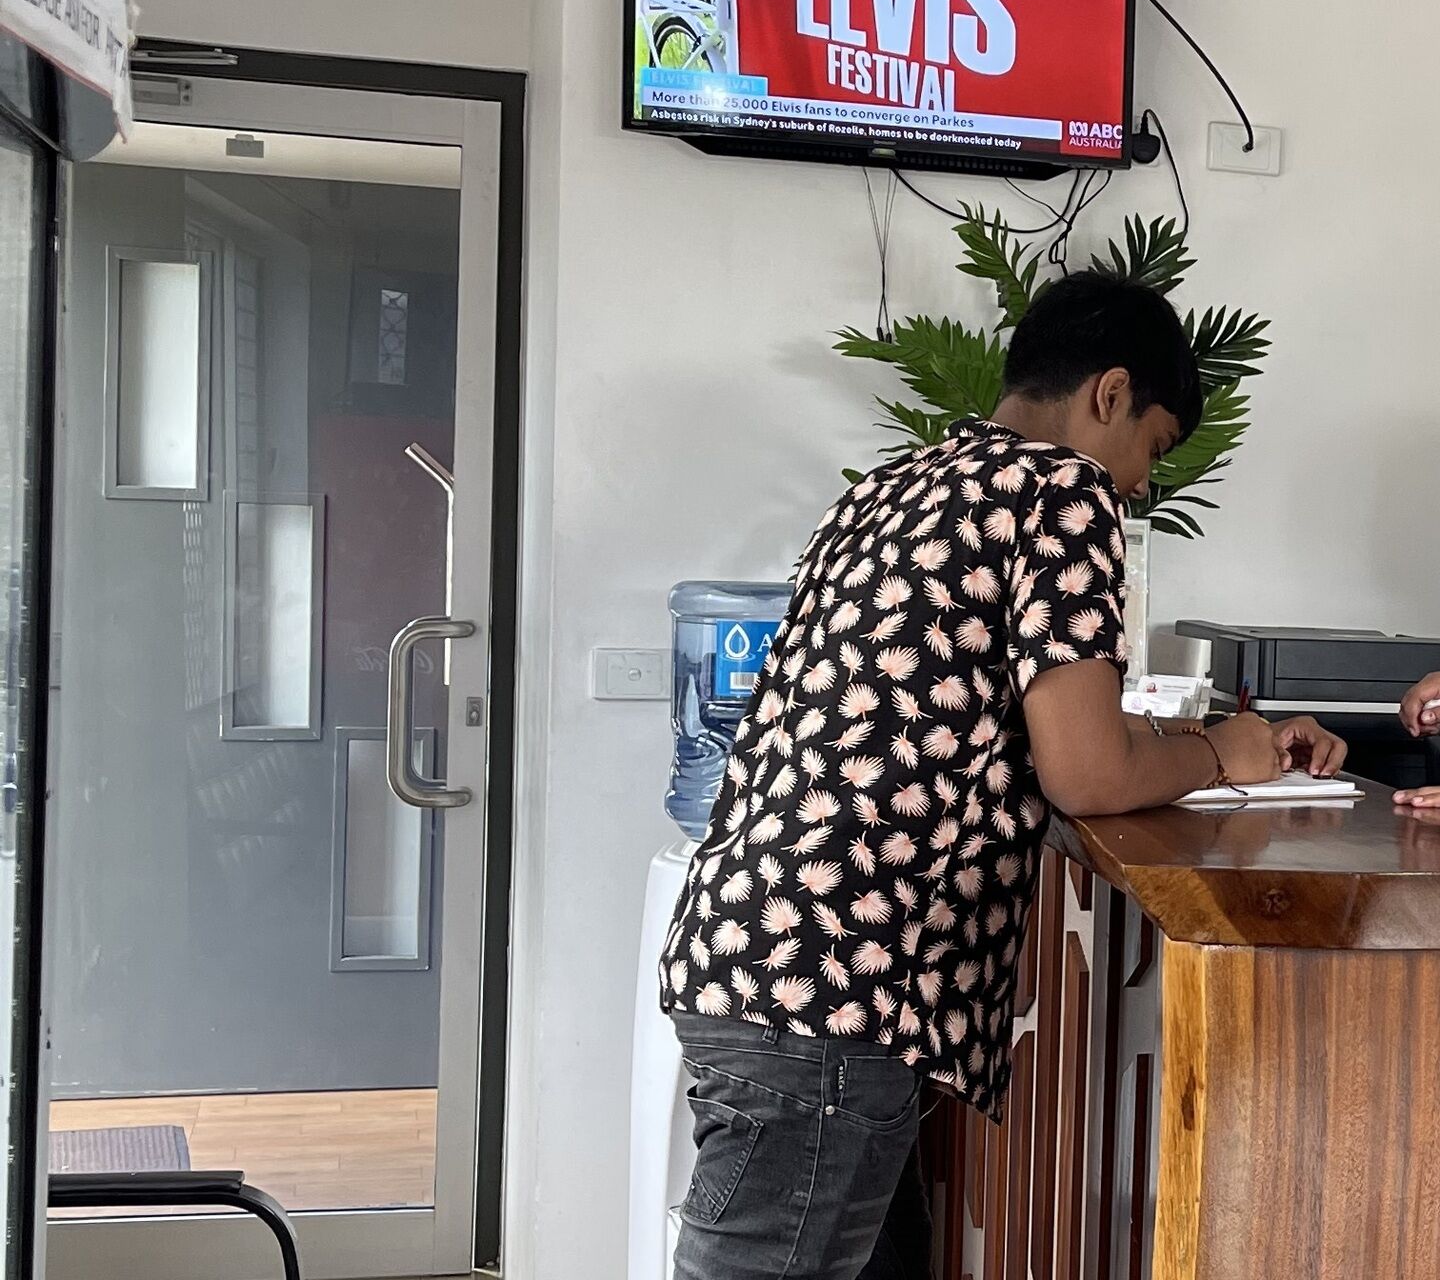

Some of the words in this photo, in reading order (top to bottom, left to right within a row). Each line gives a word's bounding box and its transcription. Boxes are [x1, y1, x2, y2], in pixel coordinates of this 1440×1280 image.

[651, 91, 686, 104] More
[772, 101, 801, 114] Elvis
[804, 103, 832, 116] fans
[835, 106, 848, 118] to
[851, 110, 911, 125] converge
[914, 113, 929, 124] on
[932, 114, 975, 129] Parkes
[650, 109, 699, 122] Asbestos
[700, 112, 720, 124] risk
[721, 114, 732, 125] in
[733, 115, 778, 130] Sydney's
[779, 118, 815, 132] suburb
[816, 120, 828, 133] of
[869, 127, 902, 139] homes
[903, 129, 914, 140] to
[915, 130, 929, 141] be
[929, 131, 993, 147] doorknocked
[994, 137, 1022, 151] today
[1089, 123, 1123, 140] ABC
